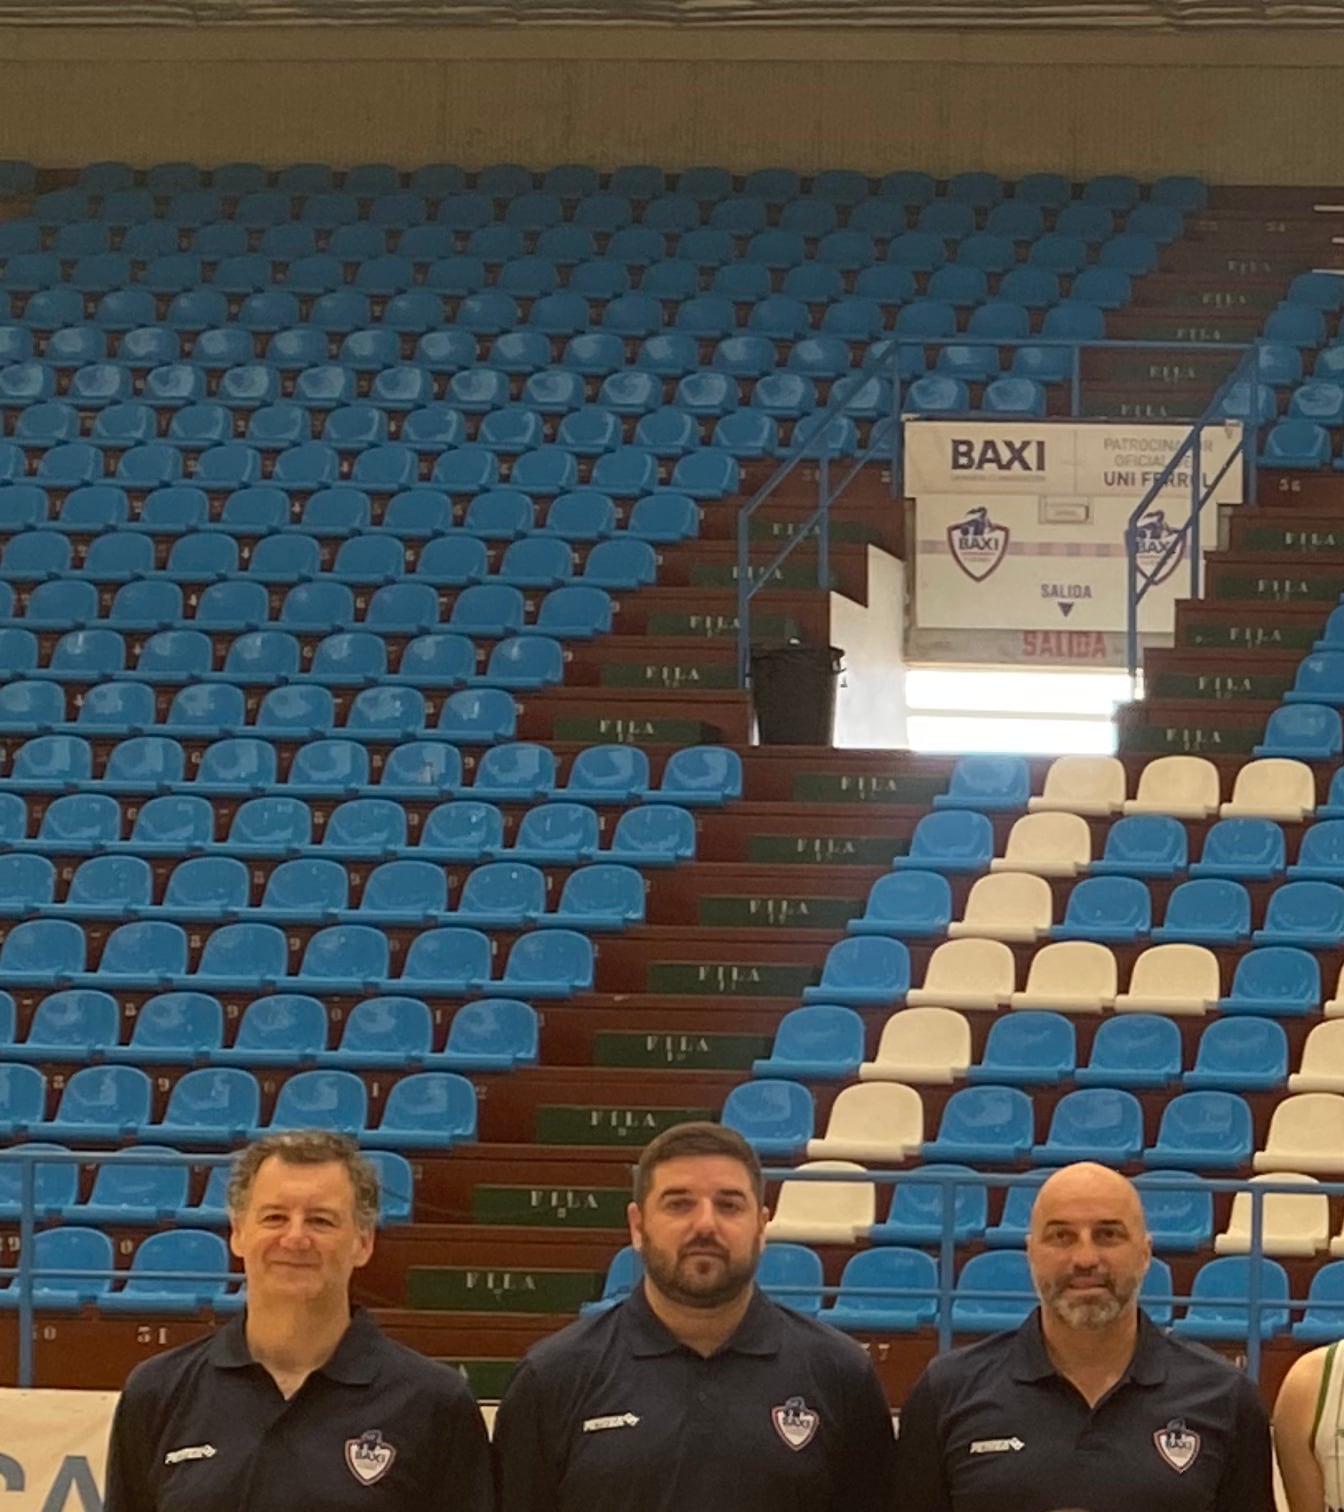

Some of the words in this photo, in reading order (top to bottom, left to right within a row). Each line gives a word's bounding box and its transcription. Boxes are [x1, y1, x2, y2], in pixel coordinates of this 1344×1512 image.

[951, 439, 1046, 472] BAXI
[1104, 471, 1136, 488] UNI
[959, 537, 999, 551] BAXI
[1285, 532, 1335, 545] FILA
[1041, 584, 1092, 600] SALIDA
[1259, 579, 1308, 592] FILA
[1230, 628, 1281, 640] FILA
[1022, 630, 1107, 659] SALIDA
[647, 667, 699, 680] FILA
[1199, 677, 1251, 690] FILA
[600, 720, 655, 733] FILA
[1167, 729, 1221, 742] FILA
[842, 776, 897, 790] FILA
[798, 838, 855, 852] FILA
[750, 900, 809, 915] FILA
[698, 966, 760, 981] FILA
[647, 1035, 708, 1051] FILA
[591, 1110, 656, 1127] FILA
[531, 1191, 598, 1208] FILA
[467, 1273, 536, 1290] FILA
[137, 1325, 168, 1345] 51
